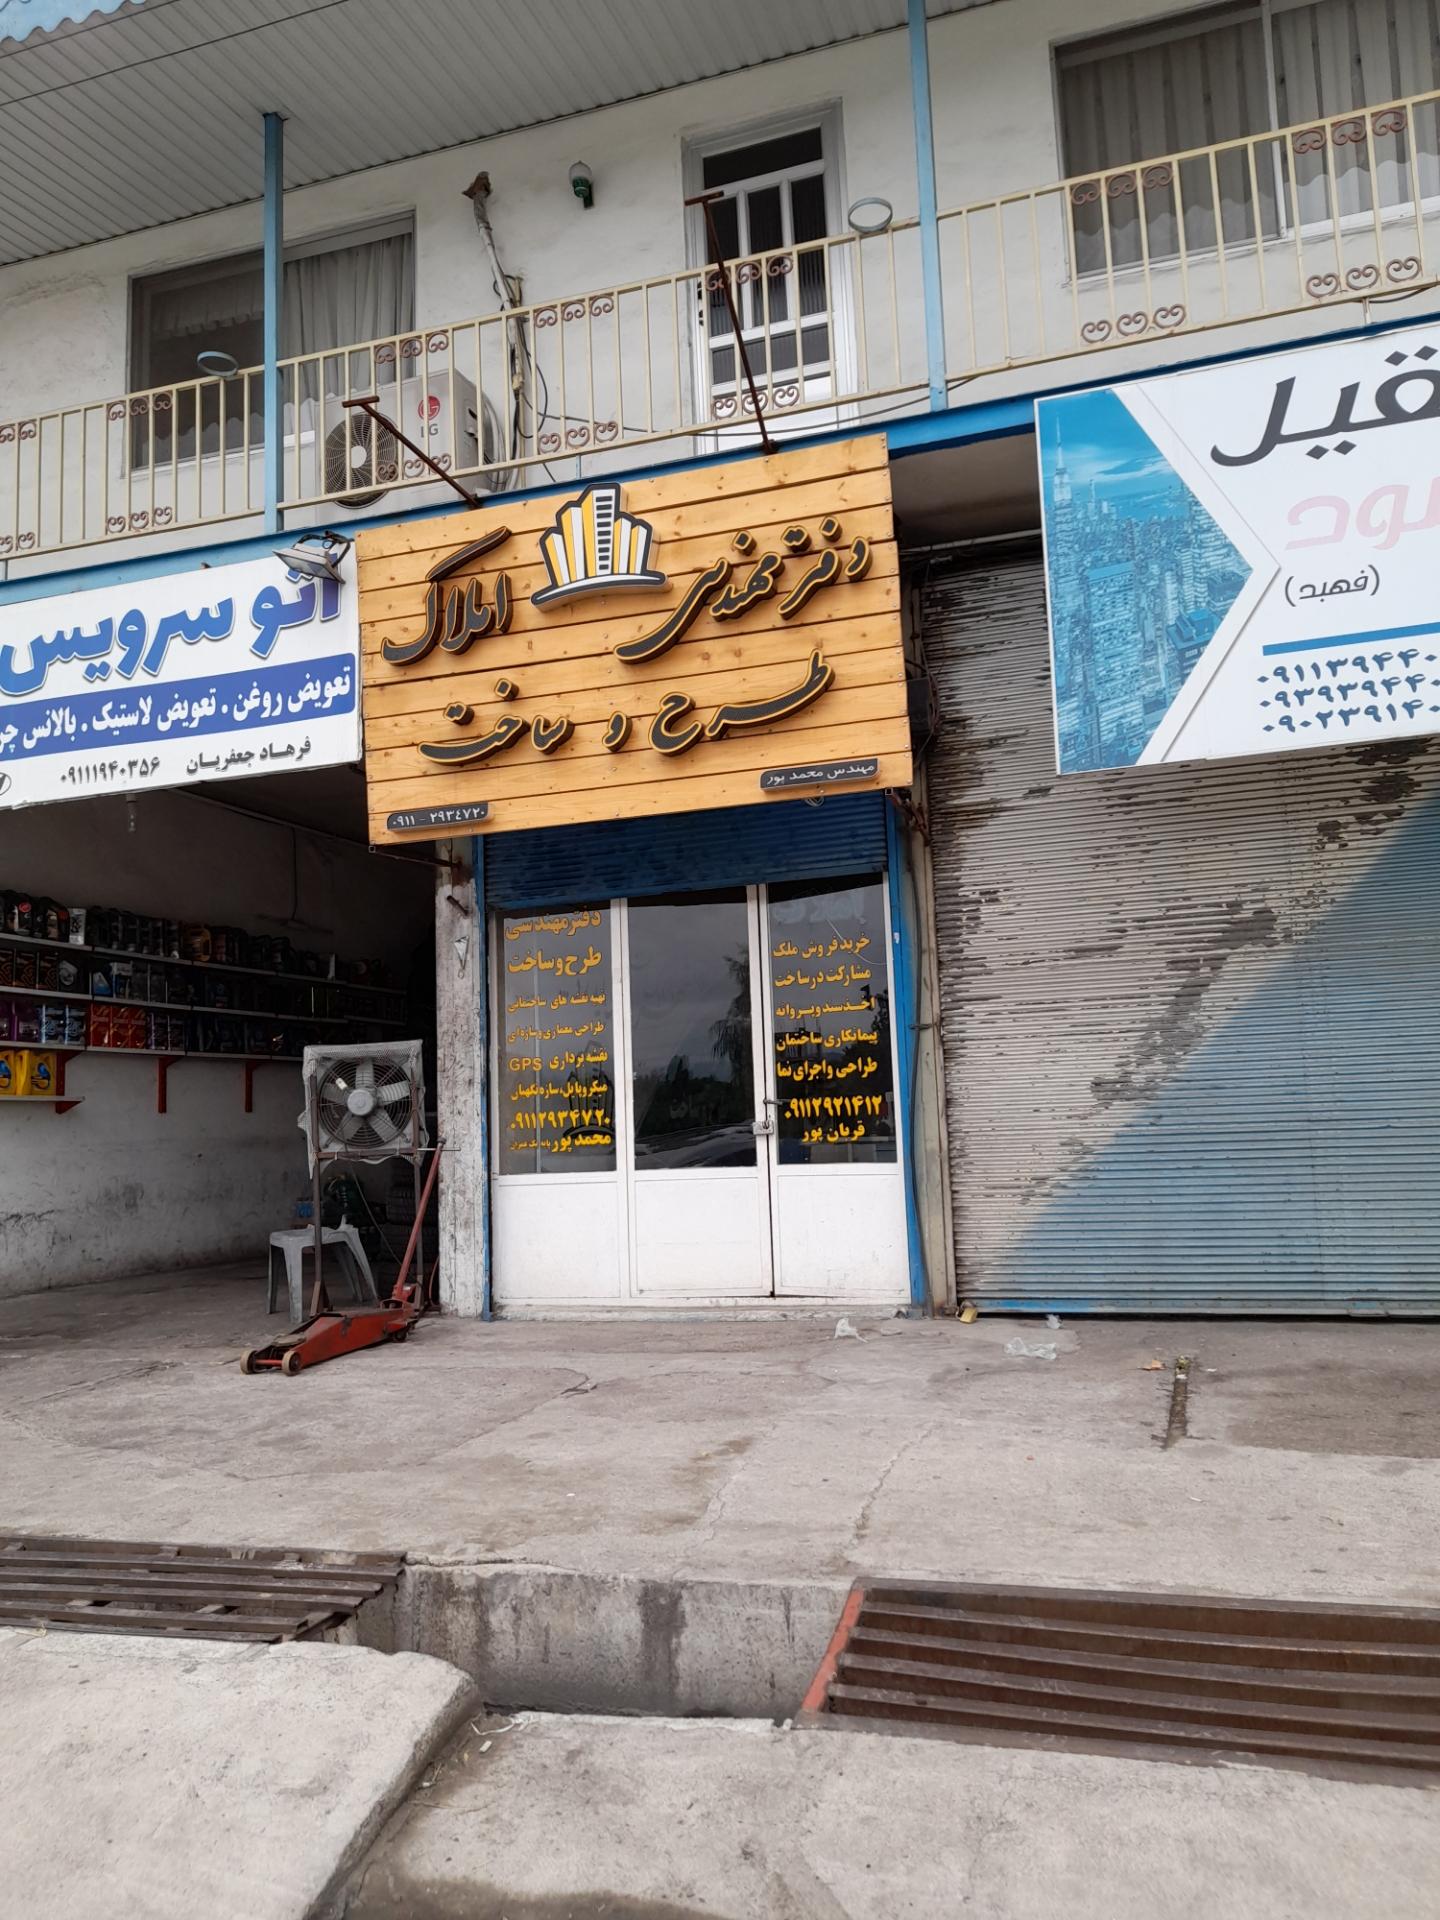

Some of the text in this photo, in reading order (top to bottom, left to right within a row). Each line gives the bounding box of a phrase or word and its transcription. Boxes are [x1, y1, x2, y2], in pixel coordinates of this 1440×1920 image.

[382, 526, 513, 666] املاک
[613, 515, 873, 664] دفتر مهندسی
[0, 596, 236, 696] سرویس
[233, 681, 283, 721] روغن
[287, 666, 351, 713] تعویض
[92, 695, 153, 736] لاستیک
[156, 688, 217, 732] تعویض
[417, 648, 836, 766] طرح و ساخت
[22, 705, 78, 750] بالانس
[60, 756, 161, 785] ۰۹۱۱۱۹۴۰۳۵۶
[186, 743, 256, 775] جعفریان
[789, 769, 824, 781] محمد
[826, 763, 875, 780] مهندس
[505, 905, 602, 941] دفتر مهندسی
[772, 932, 870, 959] خرید فروش ملک
[507, 949, 555, 973] ساخت
[564, 945, 602, 976] طرح
[774, 965, 872, 990] مشارکت در ساخت
[843, 995, 877, 1011] اخذ
[543, 1024, 574, 1040] معماری
[574, 1021, 605, 1037] طراحی
[776, 1026, 878, 1051] پیمانکاری ساختمان
[508, 1057, 542, 1072] GPS
[549, 1050, 585, 1070] برداری
[776, 1060, 792, 1078] نما
[793, 1059, 828, 1081] اجرای
[836, 1056, 878, 1079] طراحی
[510, 1108, 611, 1129] ۰۹۱۱۲۹۳۴۷۲۰
[784, 1095, 882, 1119] ۰۹۱۱۲۹۲۱۴۱۲
[574, 1133, 611, 1146] محمد
[802, 1120, 865, 1142] قربان پور
[551, 1136, 573, 1153] پور
